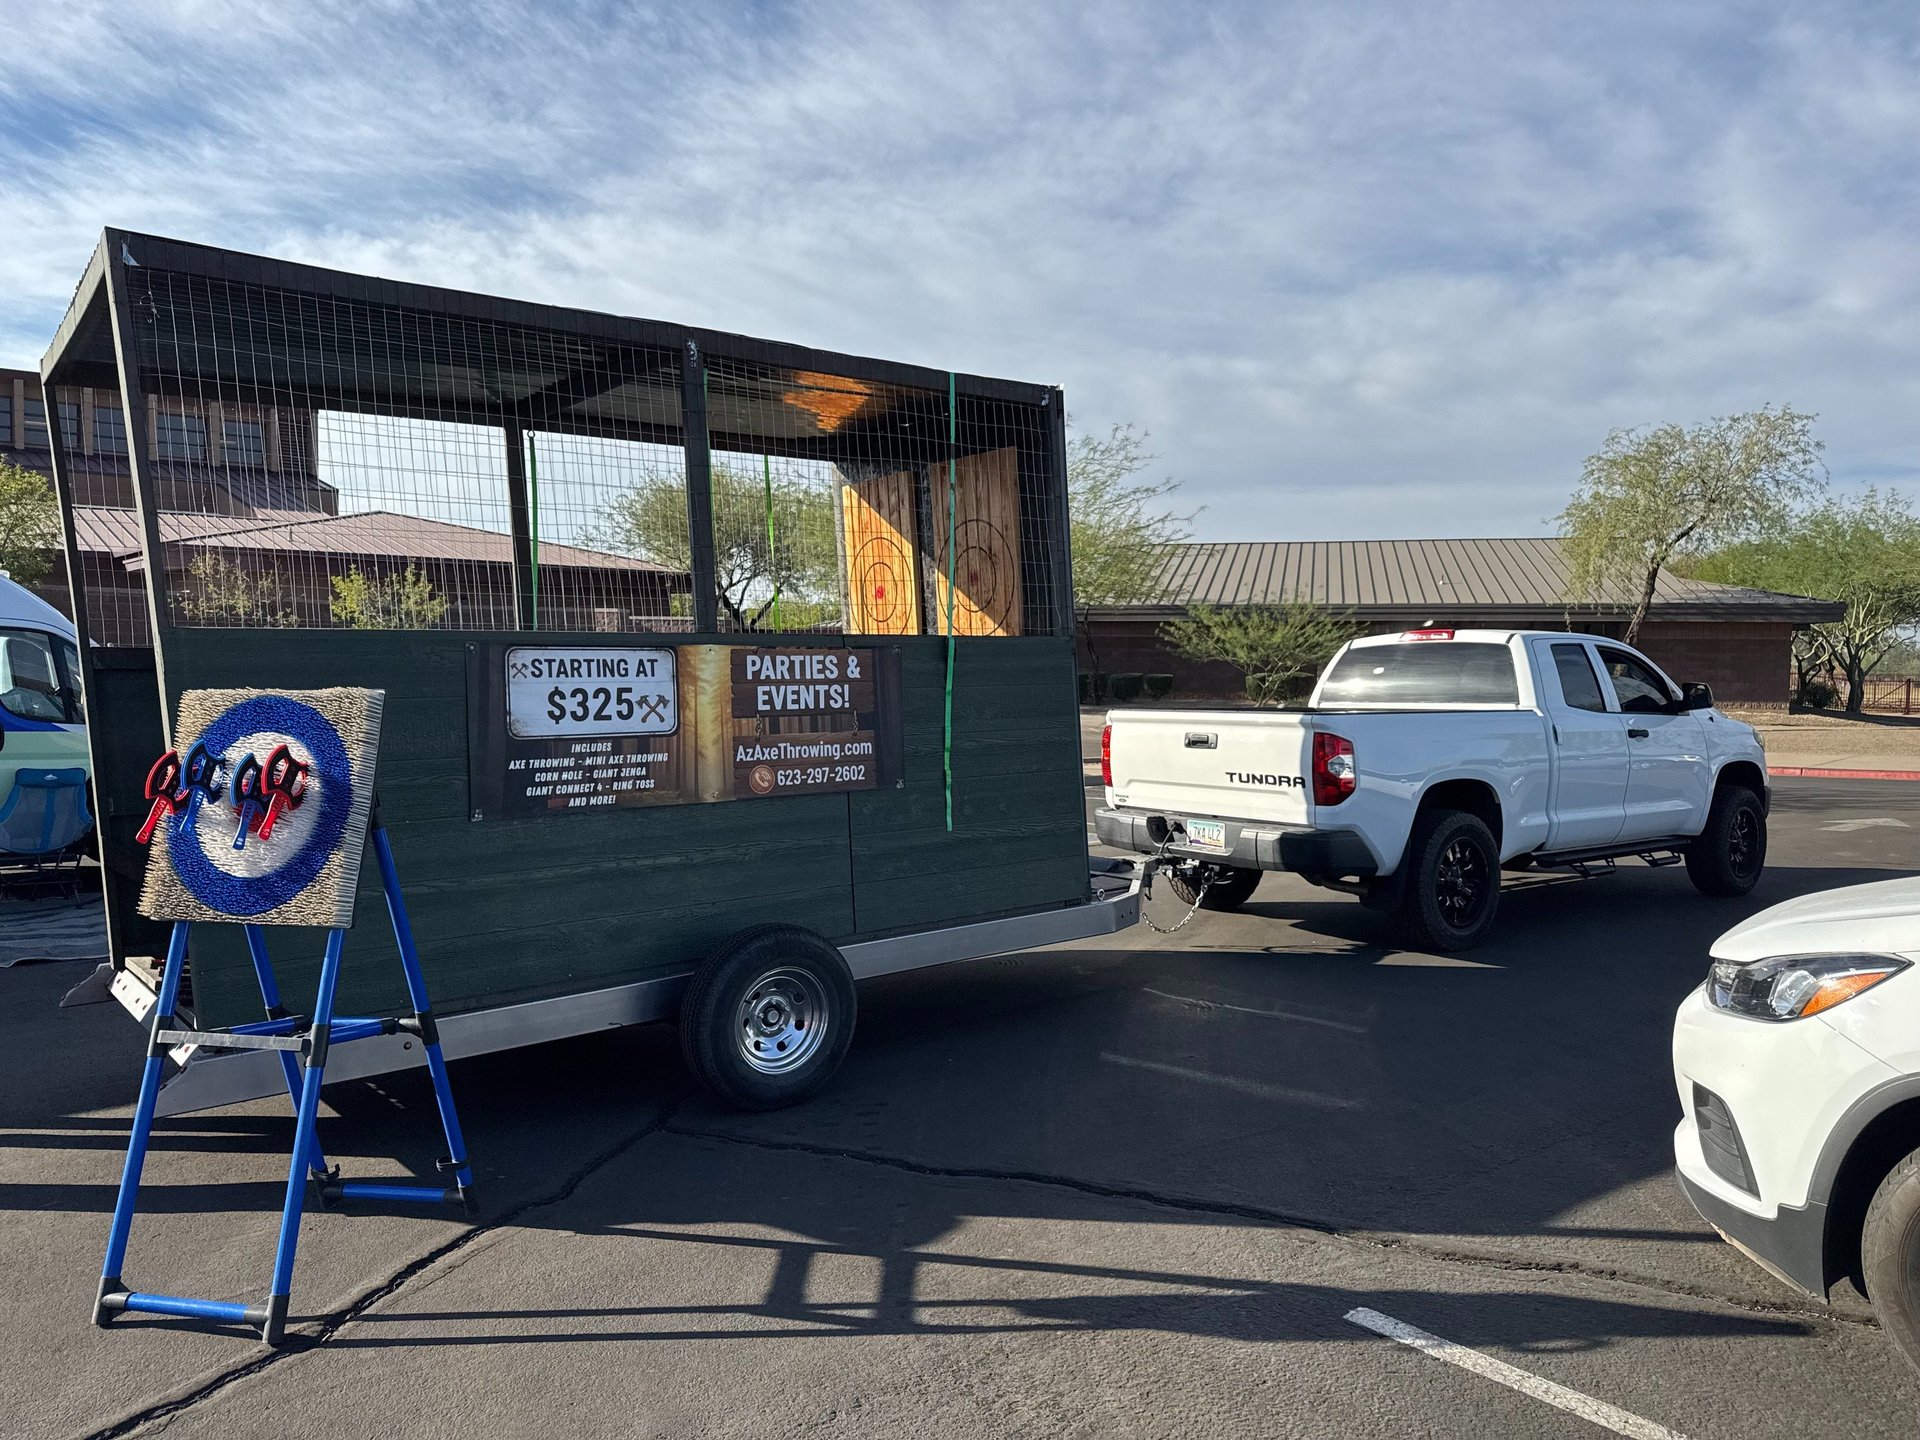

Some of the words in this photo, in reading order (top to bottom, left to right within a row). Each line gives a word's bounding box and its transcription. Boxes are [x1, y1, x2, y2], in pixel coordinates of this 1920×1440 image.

[530, 658, 629, 678] STARTING
[635, 658, 658, 677] AT
[746, 654, 839, 680] PARTIES
[846, 655, 861, 679] &
[547, 686, 634, 725] $325
[757, 684, 850, 711] EVENTS!
[571, 742, 612, 753] INCLUDES
[736, 740, 873, 762] AzAxeThrowing.com
[508, 759, 526, 770] AXE
[529, 757, 575, 769] THROWING
[585, 756, 606, 766] MINI
[608, 755, 624, 765] AXE
[626, 752, 669, 764] THROWING
[534, 772, 559, 782] CORN
[561, 770, 583, 781] HOLE
[593, 768, 619, 779] GIANT
[620, 767, 646, 777] JENGA
[777, 765, 865, 786] 623-297-2602
[1225, 771, 1306, 788] TUNDRA
[526, 785, 553, 797] GIANT
[555, 783, 594, 795] CONNECT
[596, 784, 603, 792] 4
[612, 780, 633, 791] RING
[635, 779, 655, 789] TOSS
[568, 797, 587, 807] AND
[589, 795, 616, 806] MORE!
